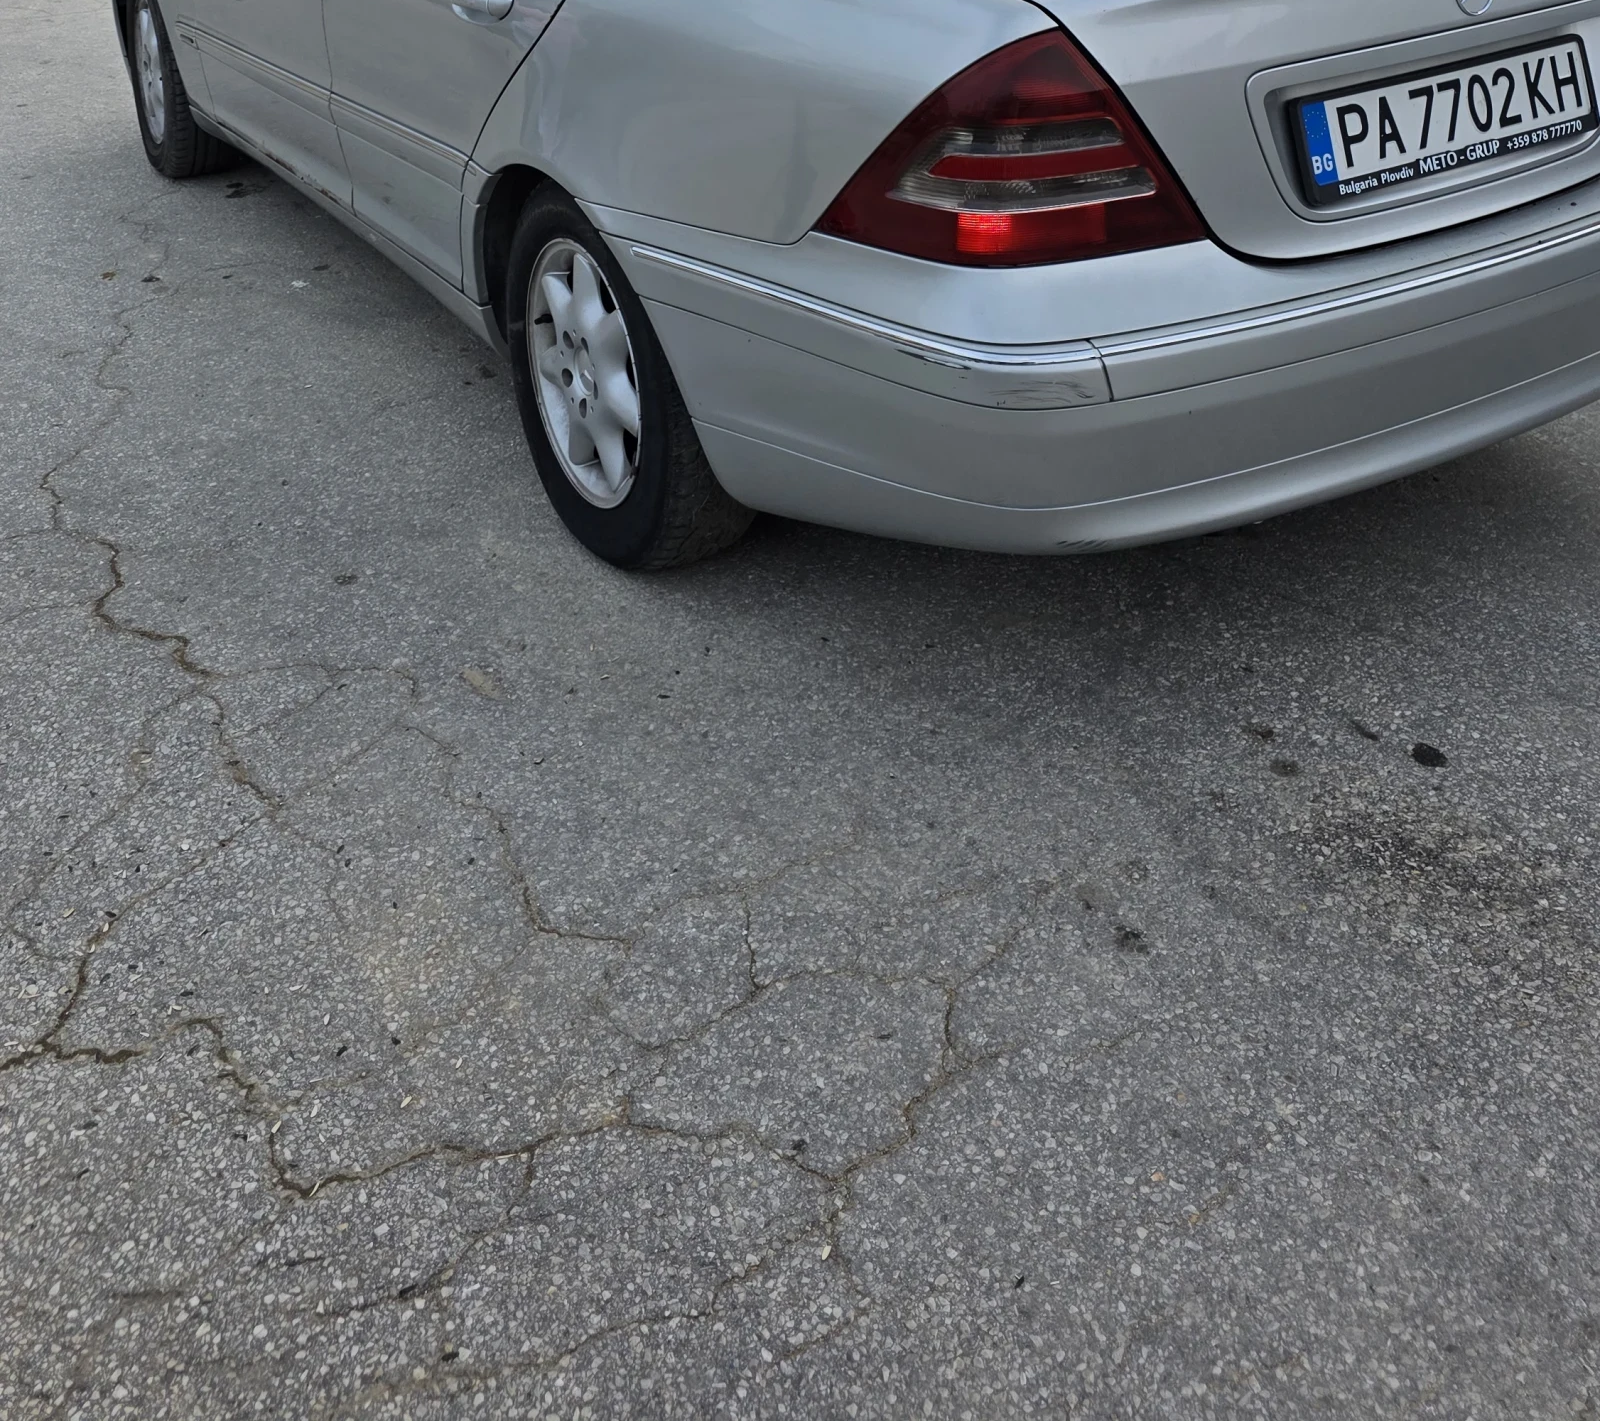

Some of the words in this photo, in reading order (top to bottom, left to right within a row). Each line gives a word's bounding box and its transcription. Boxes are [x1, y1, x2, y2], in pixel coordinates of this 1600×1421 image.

[1311, 153, 1333, 175] BG
[1338, 175, 1378, 195] Bulgaria
[1381, 166, 1414, 184] Plovdiv
[1419, 153, 1458, 175] METO
[1466, 140, 1500, 161] GRUP
[1507, 135, 1530, 150] +359
[1532, 129, 1549, 143] 878
[1550, 120, 1583, 139] 777770
